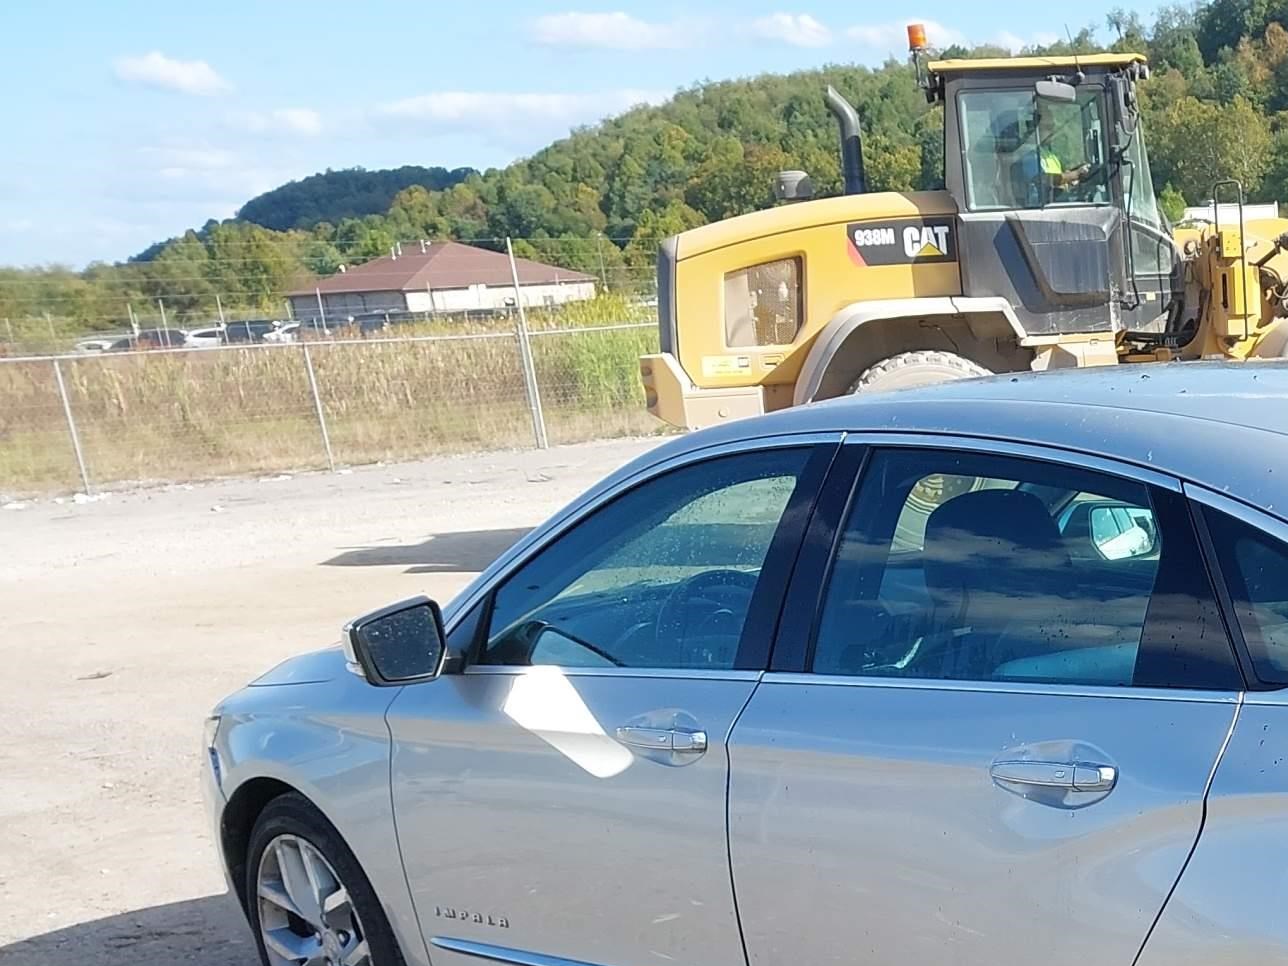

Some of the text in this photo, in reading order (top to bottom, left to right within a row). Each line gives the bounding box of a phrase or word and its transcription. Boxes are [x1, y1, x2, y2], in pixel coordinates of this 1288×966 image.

[854, 226, 949, 257] 938M CAT
[434, 906, 510, 928] IMPALA
